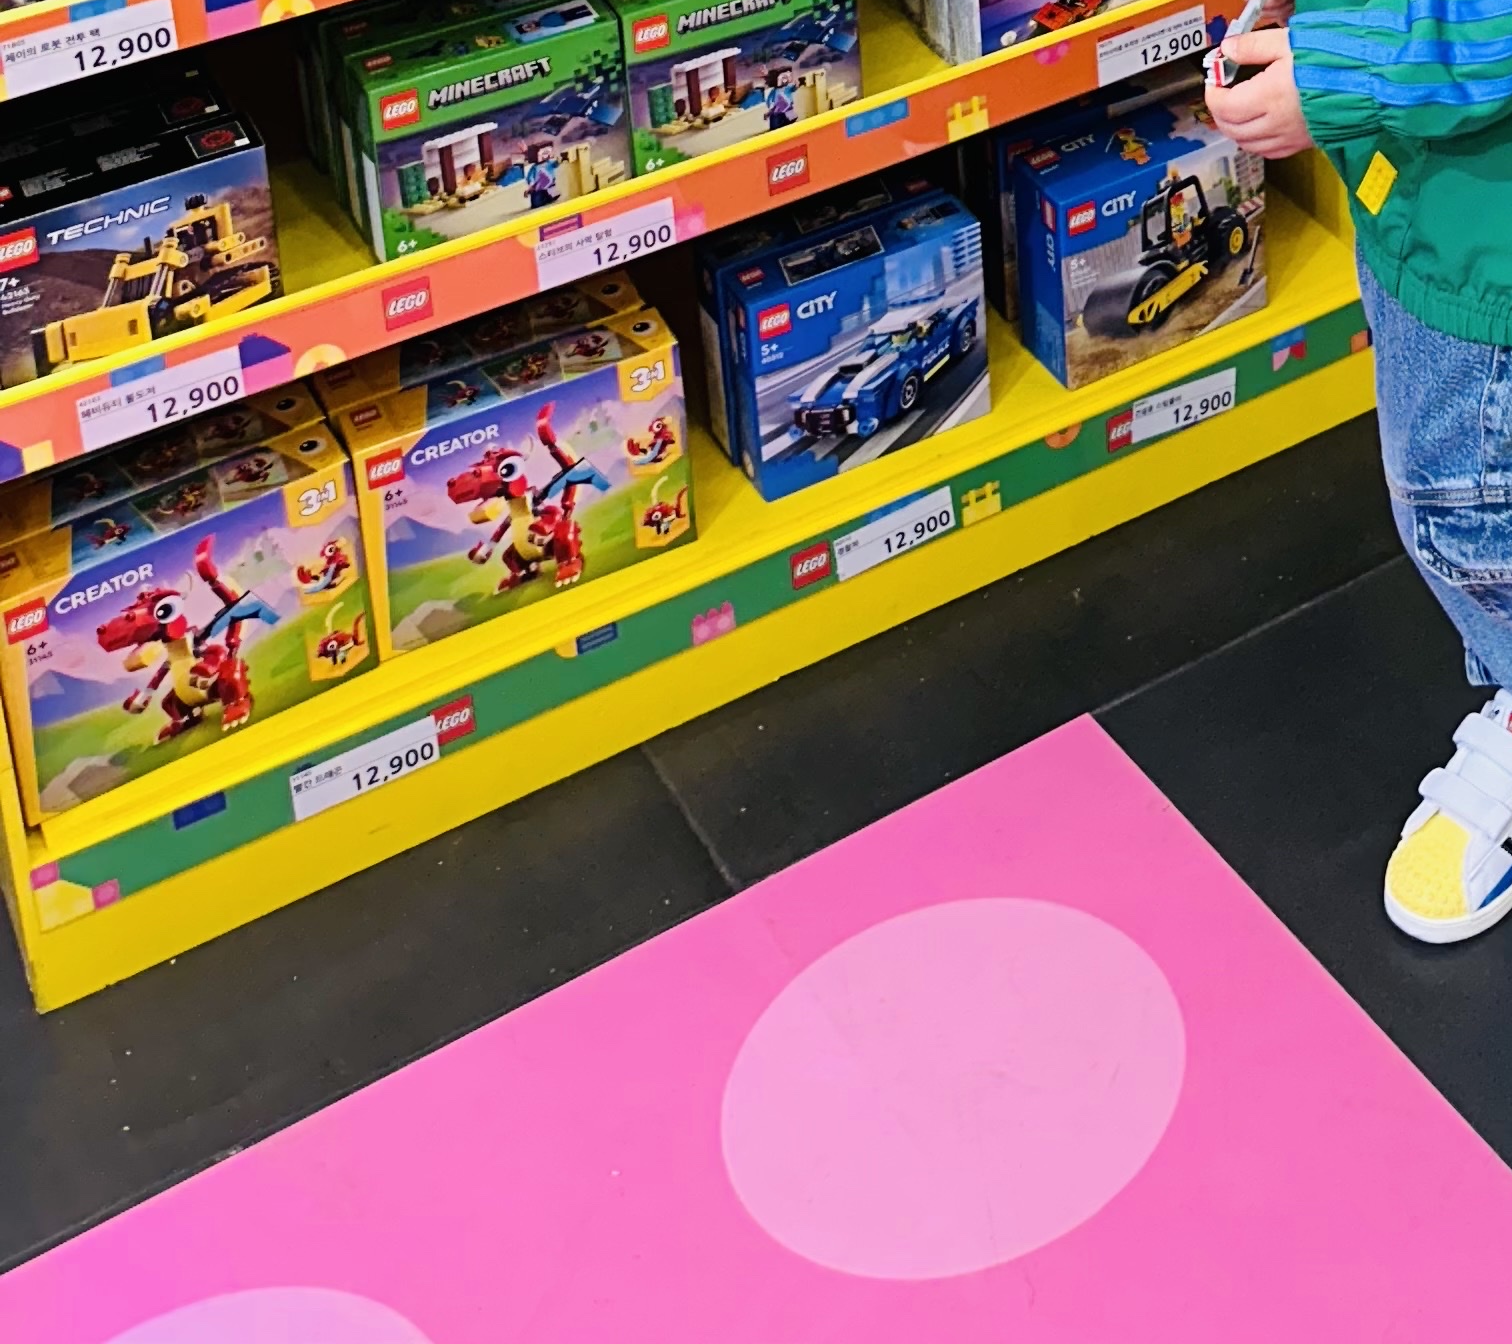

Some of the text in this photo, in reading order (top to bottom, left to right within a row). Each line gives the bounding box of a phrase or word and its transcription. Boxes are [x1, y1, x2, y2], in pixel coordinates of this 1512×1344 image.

[6, 47, 36, 62] 제이의
[65, 33, 86, 45] 전투
[635, 24, 668, 43] LEGO
[1141, 30, 1202, 65] 12,900
[75, 28, 170, 71] 12,900
[426, 57, 552, 108] MINECRAFT
[382, 99, 419, 122] LEGO
[1061, 134, 1096, 152] CITY
[645, 157, 666, 172] 6+
[1102, 190, 1136, 216] CITY
[46, 197, 172, 245] TECHNIC
[1069, 208, 1095, 229] LEGO
[397, 236, 417, 253] 6+
[593, 225, 671, 265] 12,900
[1071, 258, 1086, 269] 5+
[797, 291, 838, 319] CITY
[760, 311, 789, 331] LEGO
[761, 344, 779, 356] 5+
[147, 376, 239, 423] 12,900
[1174, 391, 1231, 424] 12,900
[411, 423, 499, 466] CREATOR
[384, 489, 404, 502] 6+
[883, 510, 951, 556] 12,900
[54, 563, 154, 615] CREATOR
[26, 641, 48, 656] 6+
[353, 742, 434, 791] 12,900
